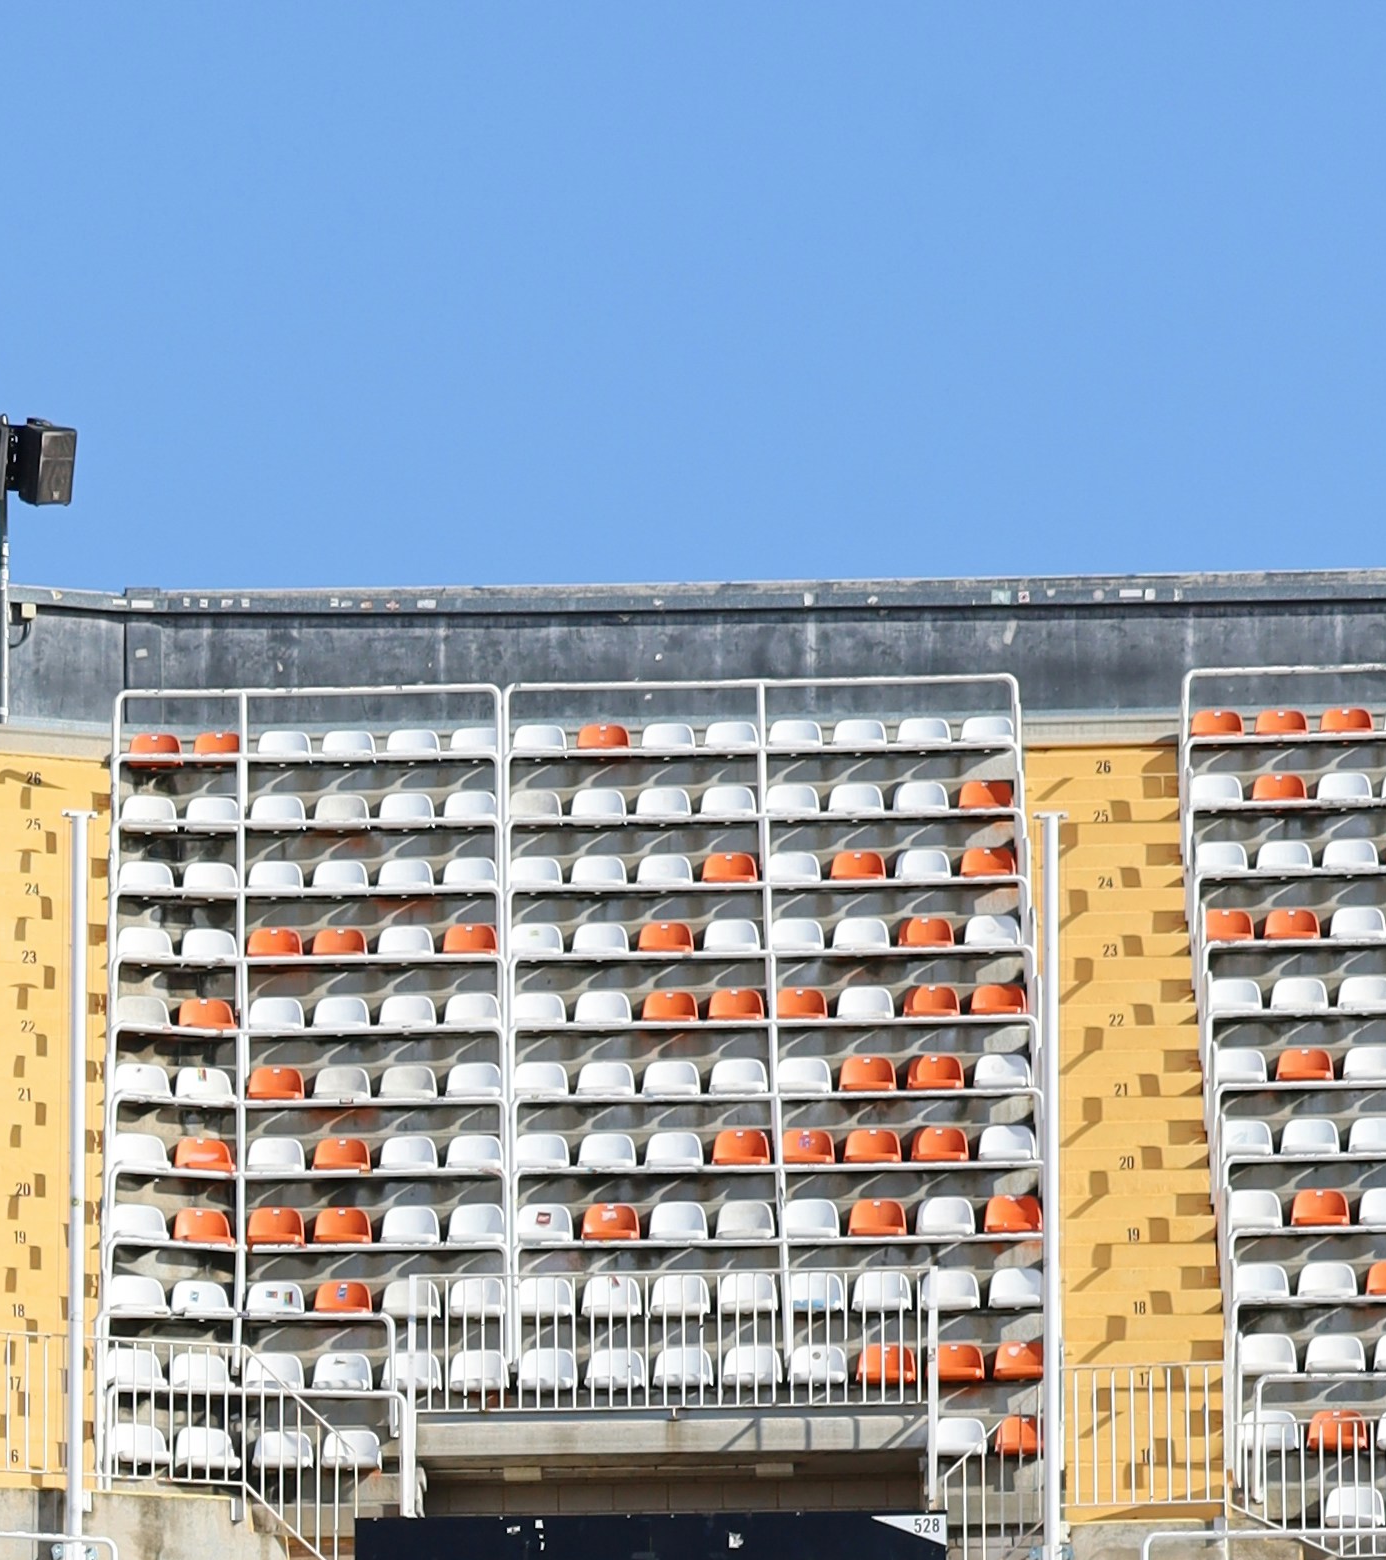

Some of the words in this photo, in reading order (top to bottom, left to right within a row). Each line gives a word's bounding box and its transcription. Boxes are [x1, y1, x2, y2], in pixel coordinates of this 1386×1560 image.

[1095, 760, 1111, 774] 26
[26, 771, 41, 785] 26
[1093, 810, 1109, 823] 25
[26, 818, 41, 830] 25
[1098, 876, 1113, 889] 24
[24, 883, 40, 896] 24
[1102, 944, 1118, 957] 23
[22, 951, 37, 964] 23
[21, 1020, 36, 1032] 22
[1109, 1014, 1124, 1026] 22
[18, 1088, 32, 1102] 21
[1114, 1083, 1128, 1095] 21
[1119, 1156, 1134, 1169] 20
[15, 1182, 31, 1197] 20
[14, 1231, 26, 1244] 19
[1127, 1228, 1140, 1242] 19
[12, 1304, 25, 1318] 18
[1133, 1301, 1146, 1315] 18
[10, 1376, 22, 1391] 17
[11, 1449, 19, 1463] 6
[913, 1518, 940, 1535] 528
